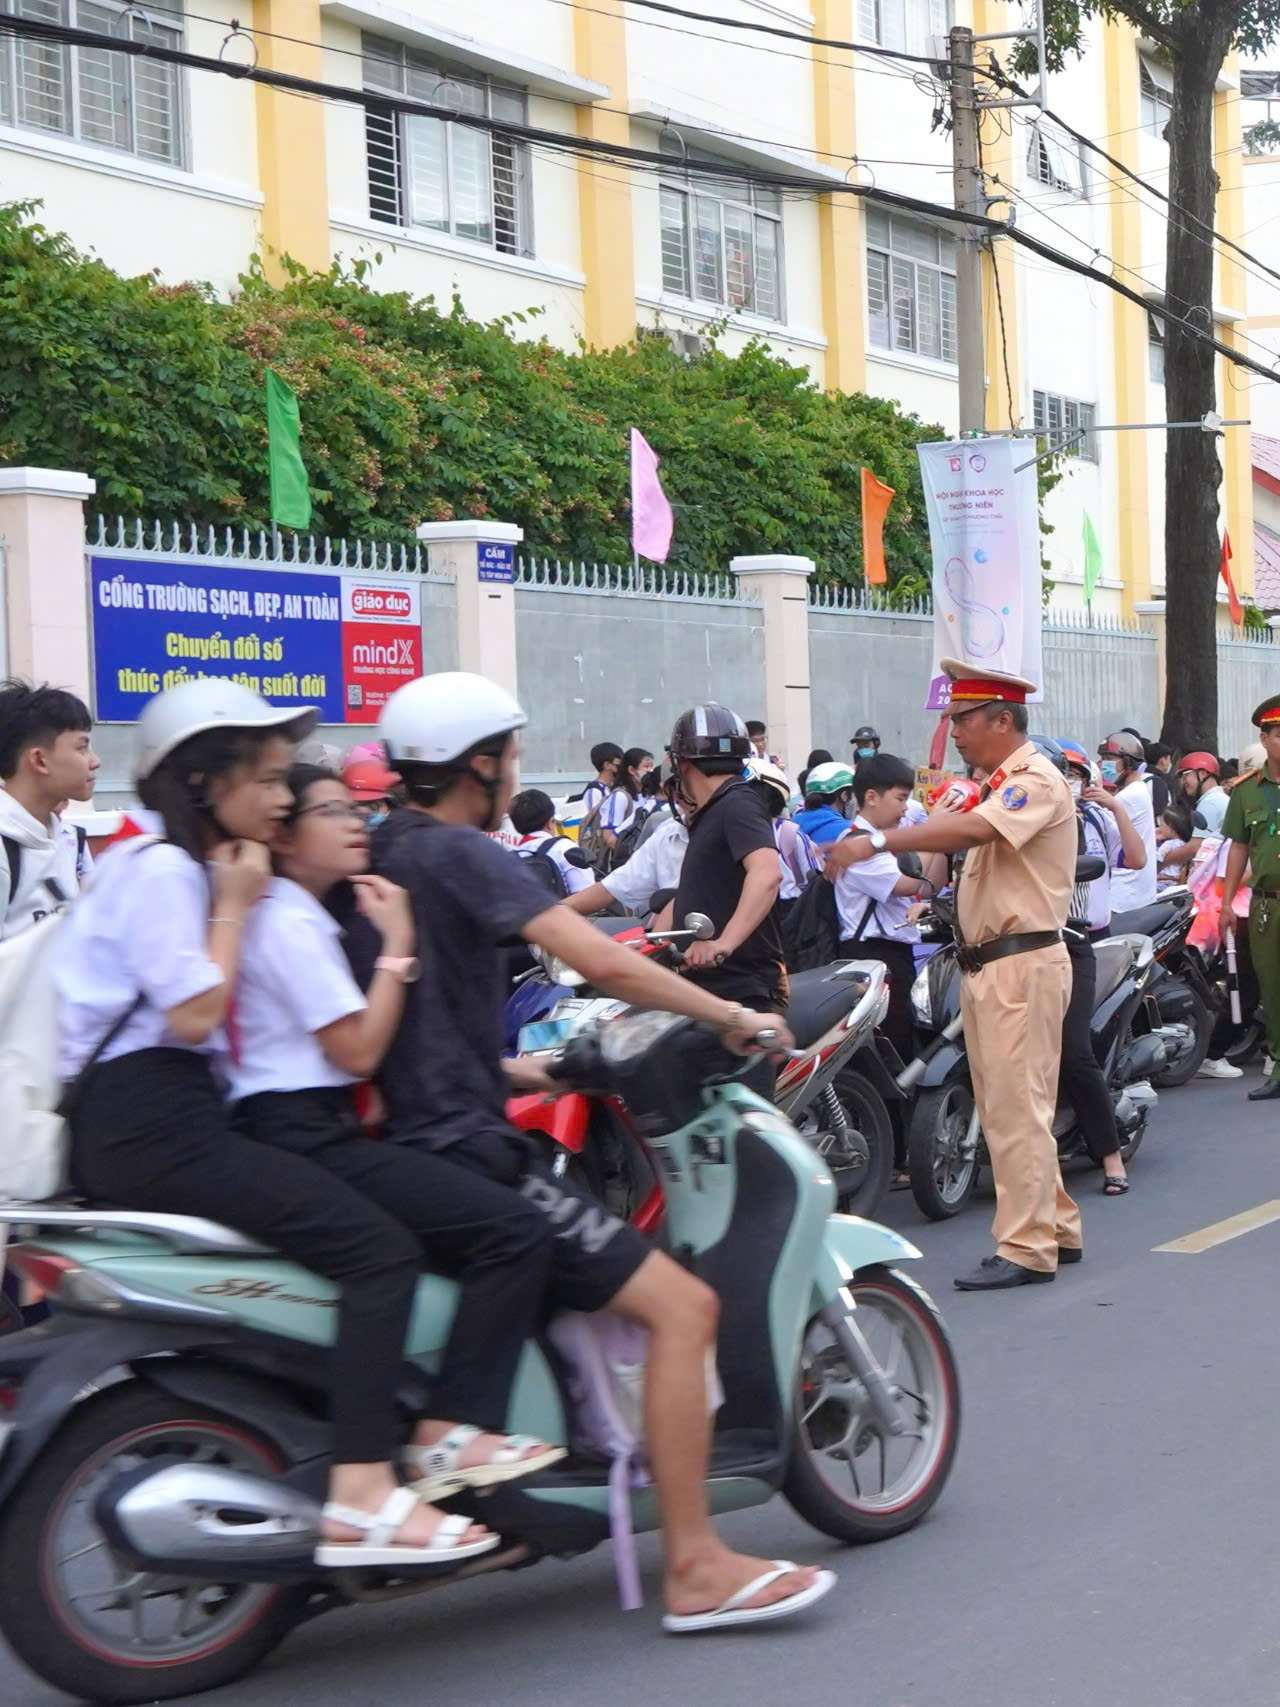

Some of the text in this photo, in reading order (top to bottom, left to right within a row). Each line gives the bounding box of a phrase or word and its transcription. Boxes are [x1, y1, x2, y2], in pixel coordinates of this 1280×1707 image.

[964, 489, 986, 497] KHOA
[988, 488, 1005, 498] HỌC
[485, 546, 505, 559] CẤM
[99, 574, 339, 623] CỔNG TRƯỜNG SẠCH, ĐẸP, AN TOÀN
[354, 590, 384, 611] giáo
[165, 631, 284, 661] Chuyển đổi số
[353, 640, 414, 665] mindX
[117, 668, 160, 693] thúc
[263, 672, 299, 697] suốt
[301, 674, 326, 697] đời
